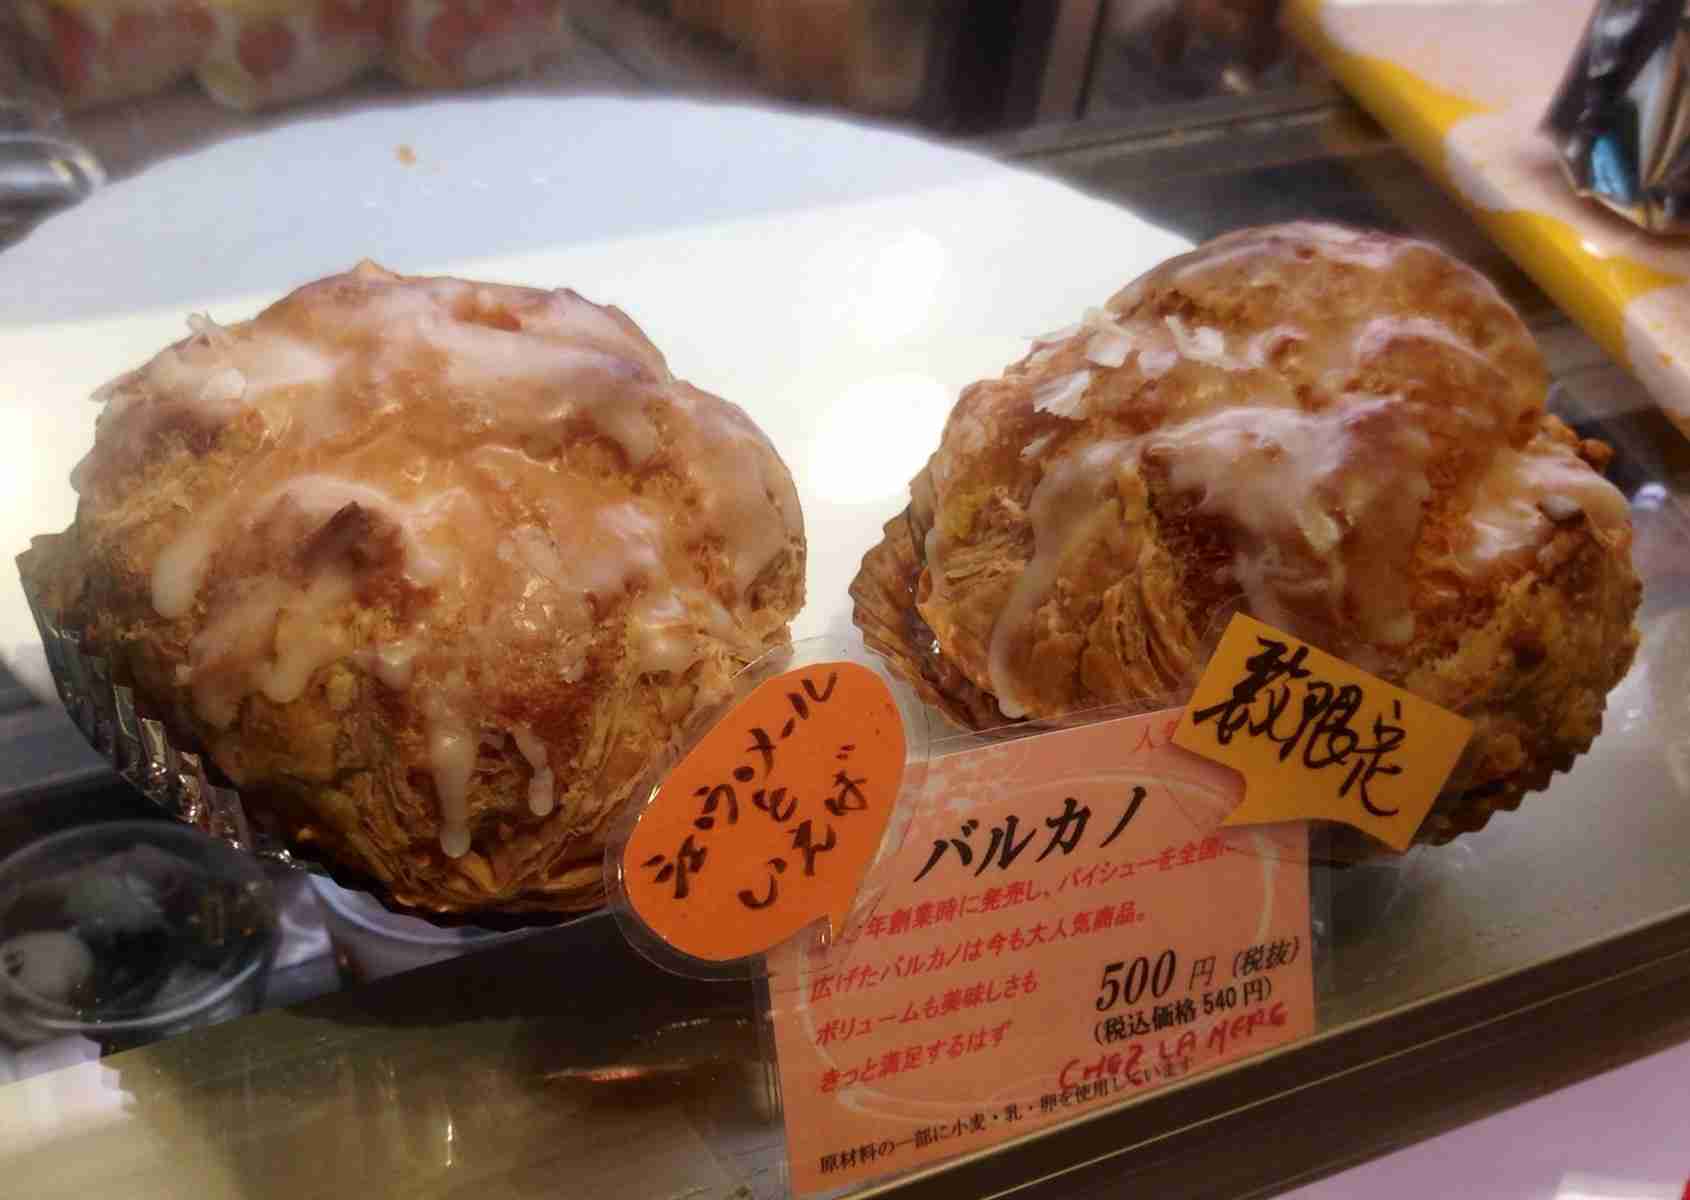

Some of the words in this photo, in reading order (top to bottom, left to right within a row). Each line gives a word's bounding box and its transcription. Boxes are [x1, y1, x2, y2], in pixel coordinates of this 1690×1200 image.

[752, 787, 797, 822] と
[913, 786, 1147, 882] バルカノ
[816, 970, 1039, 1046] ボリュームも美味しさも
[1096, 949, 1176, 1012] 500
[1188, 955, 1216, 992] 円
[1203, 986, 1237, 1016] 540
[820, 1020, 1013, 1094] きっと満足するはず
